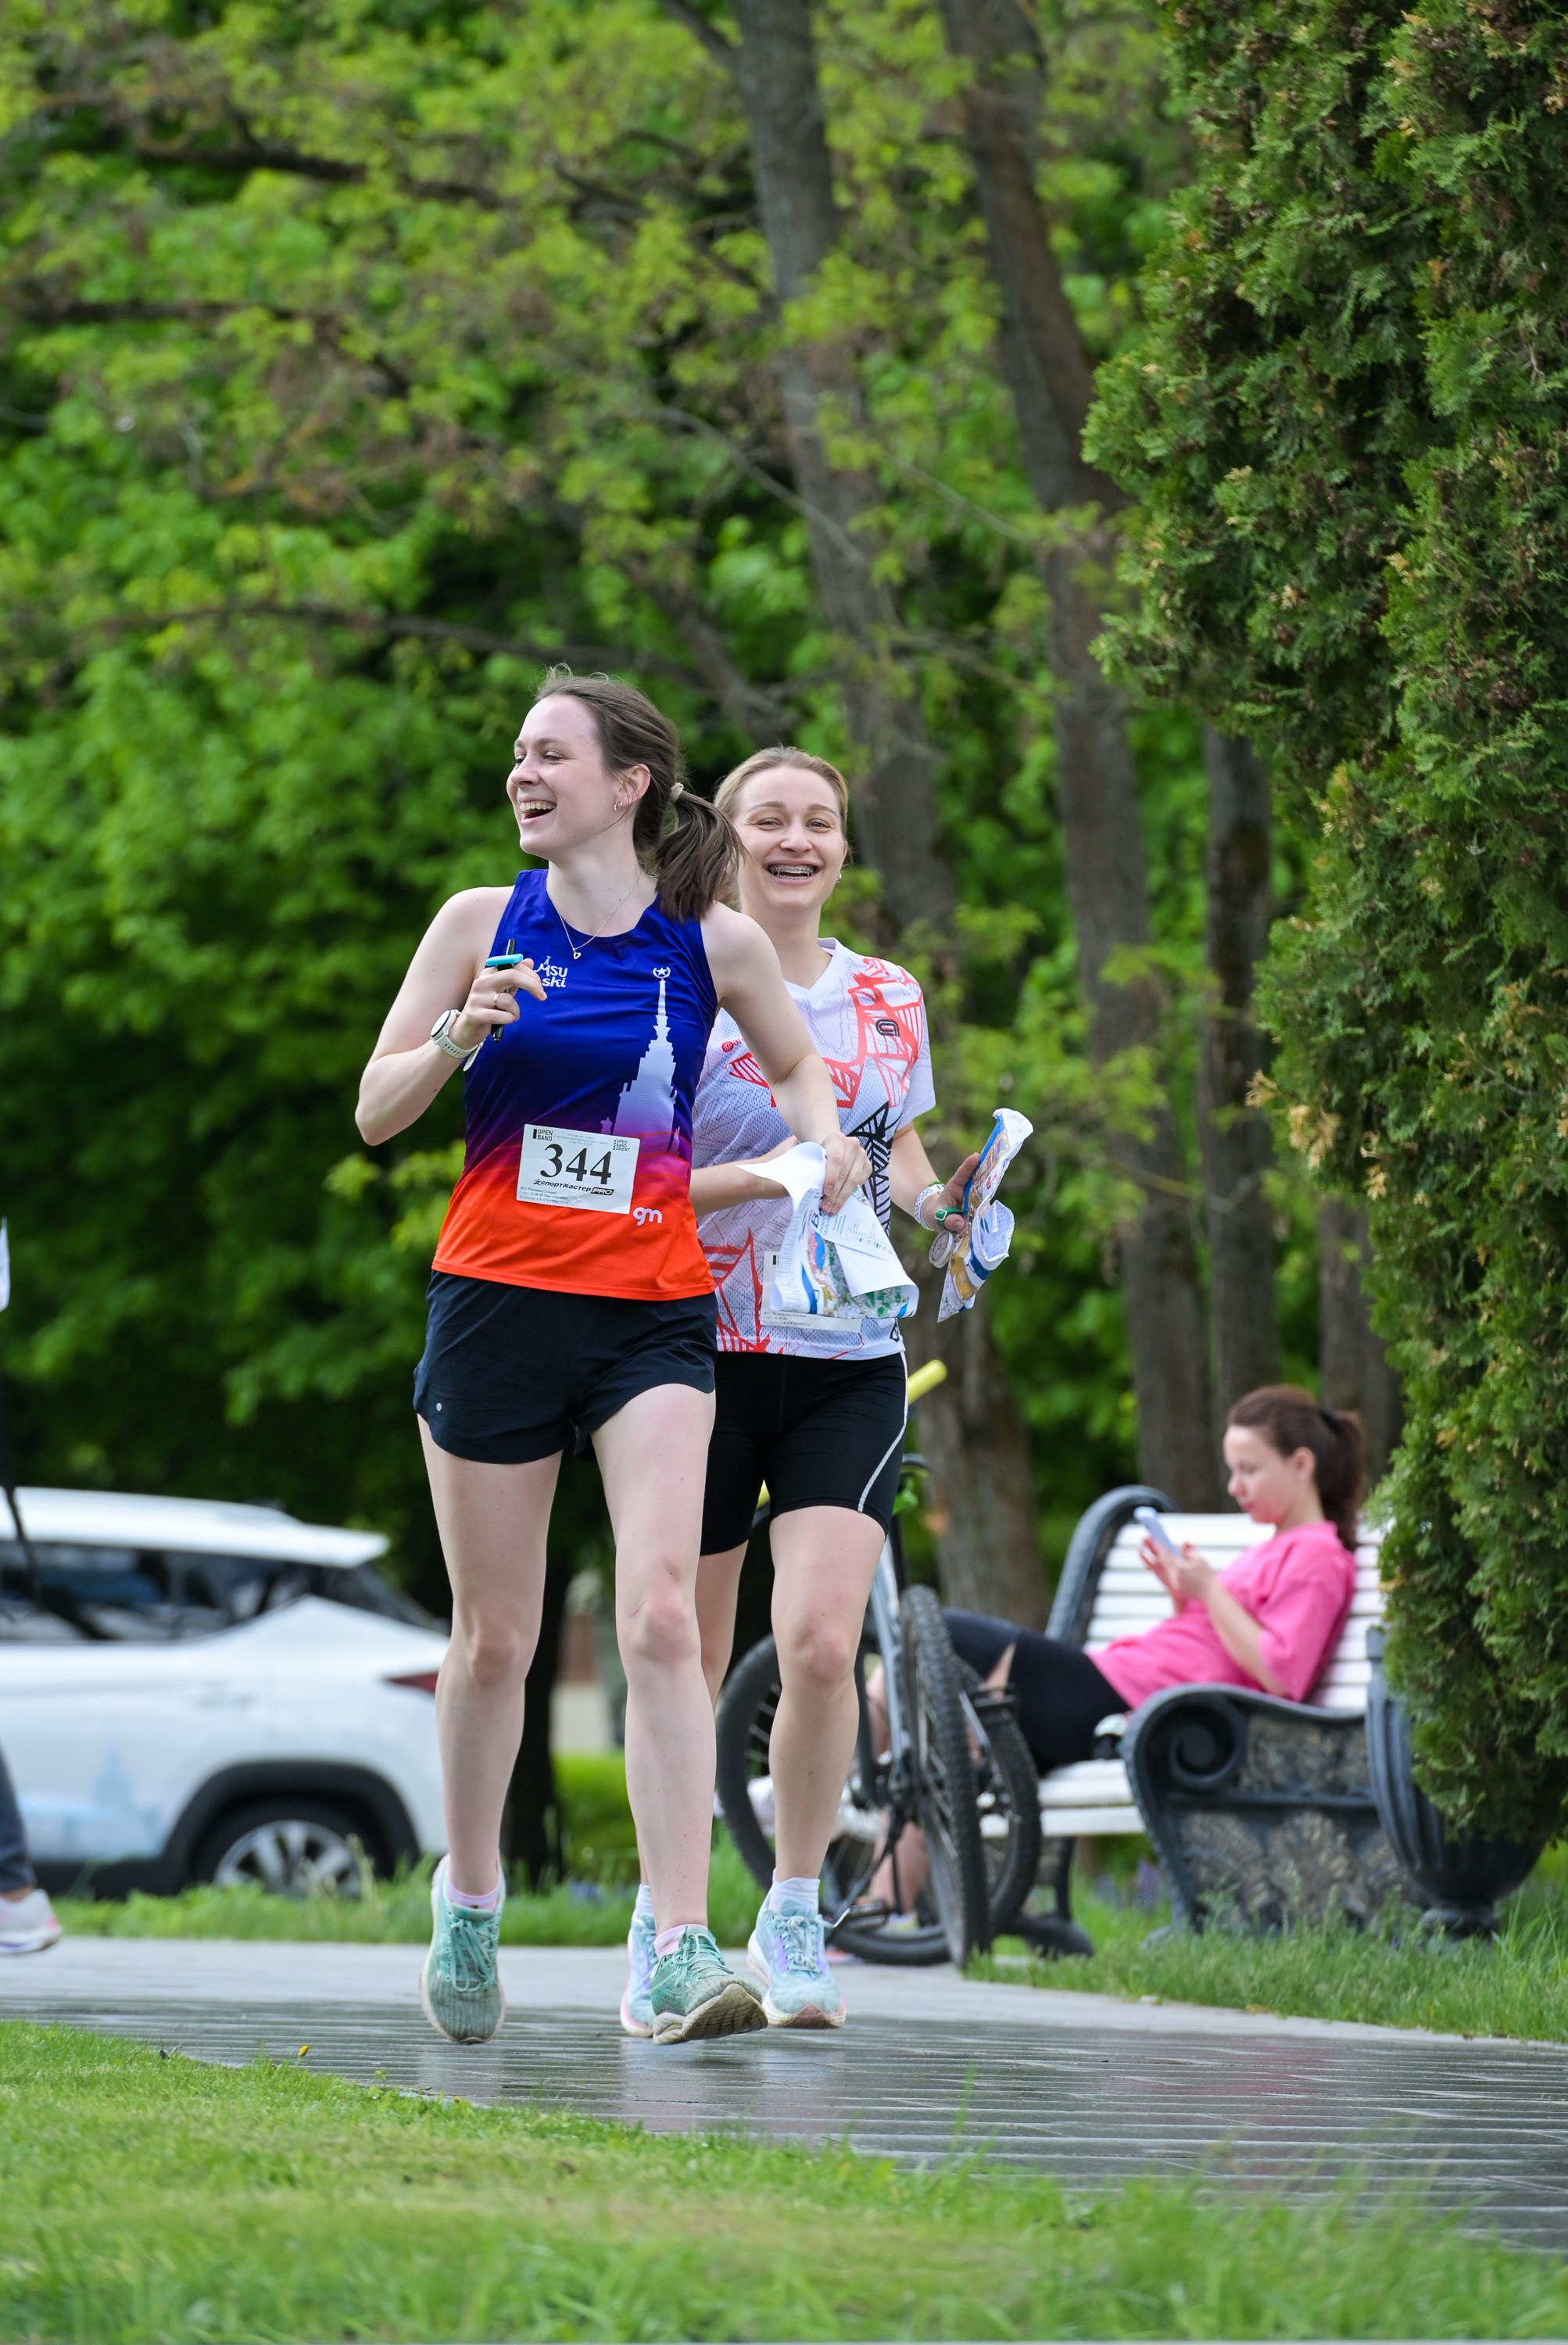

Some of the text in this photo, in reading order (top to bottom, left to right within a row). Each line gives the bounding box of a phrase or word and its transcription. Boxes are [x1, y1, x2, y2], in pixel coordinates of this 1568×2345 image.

[533, 958, 568, 977] MSU
[542, 976, 567, 988] ski
[540, 1144, 612, 1185] 344
[592, 1187, 614, 1196] PRO
[632, 1206, 663, 1226] gm
